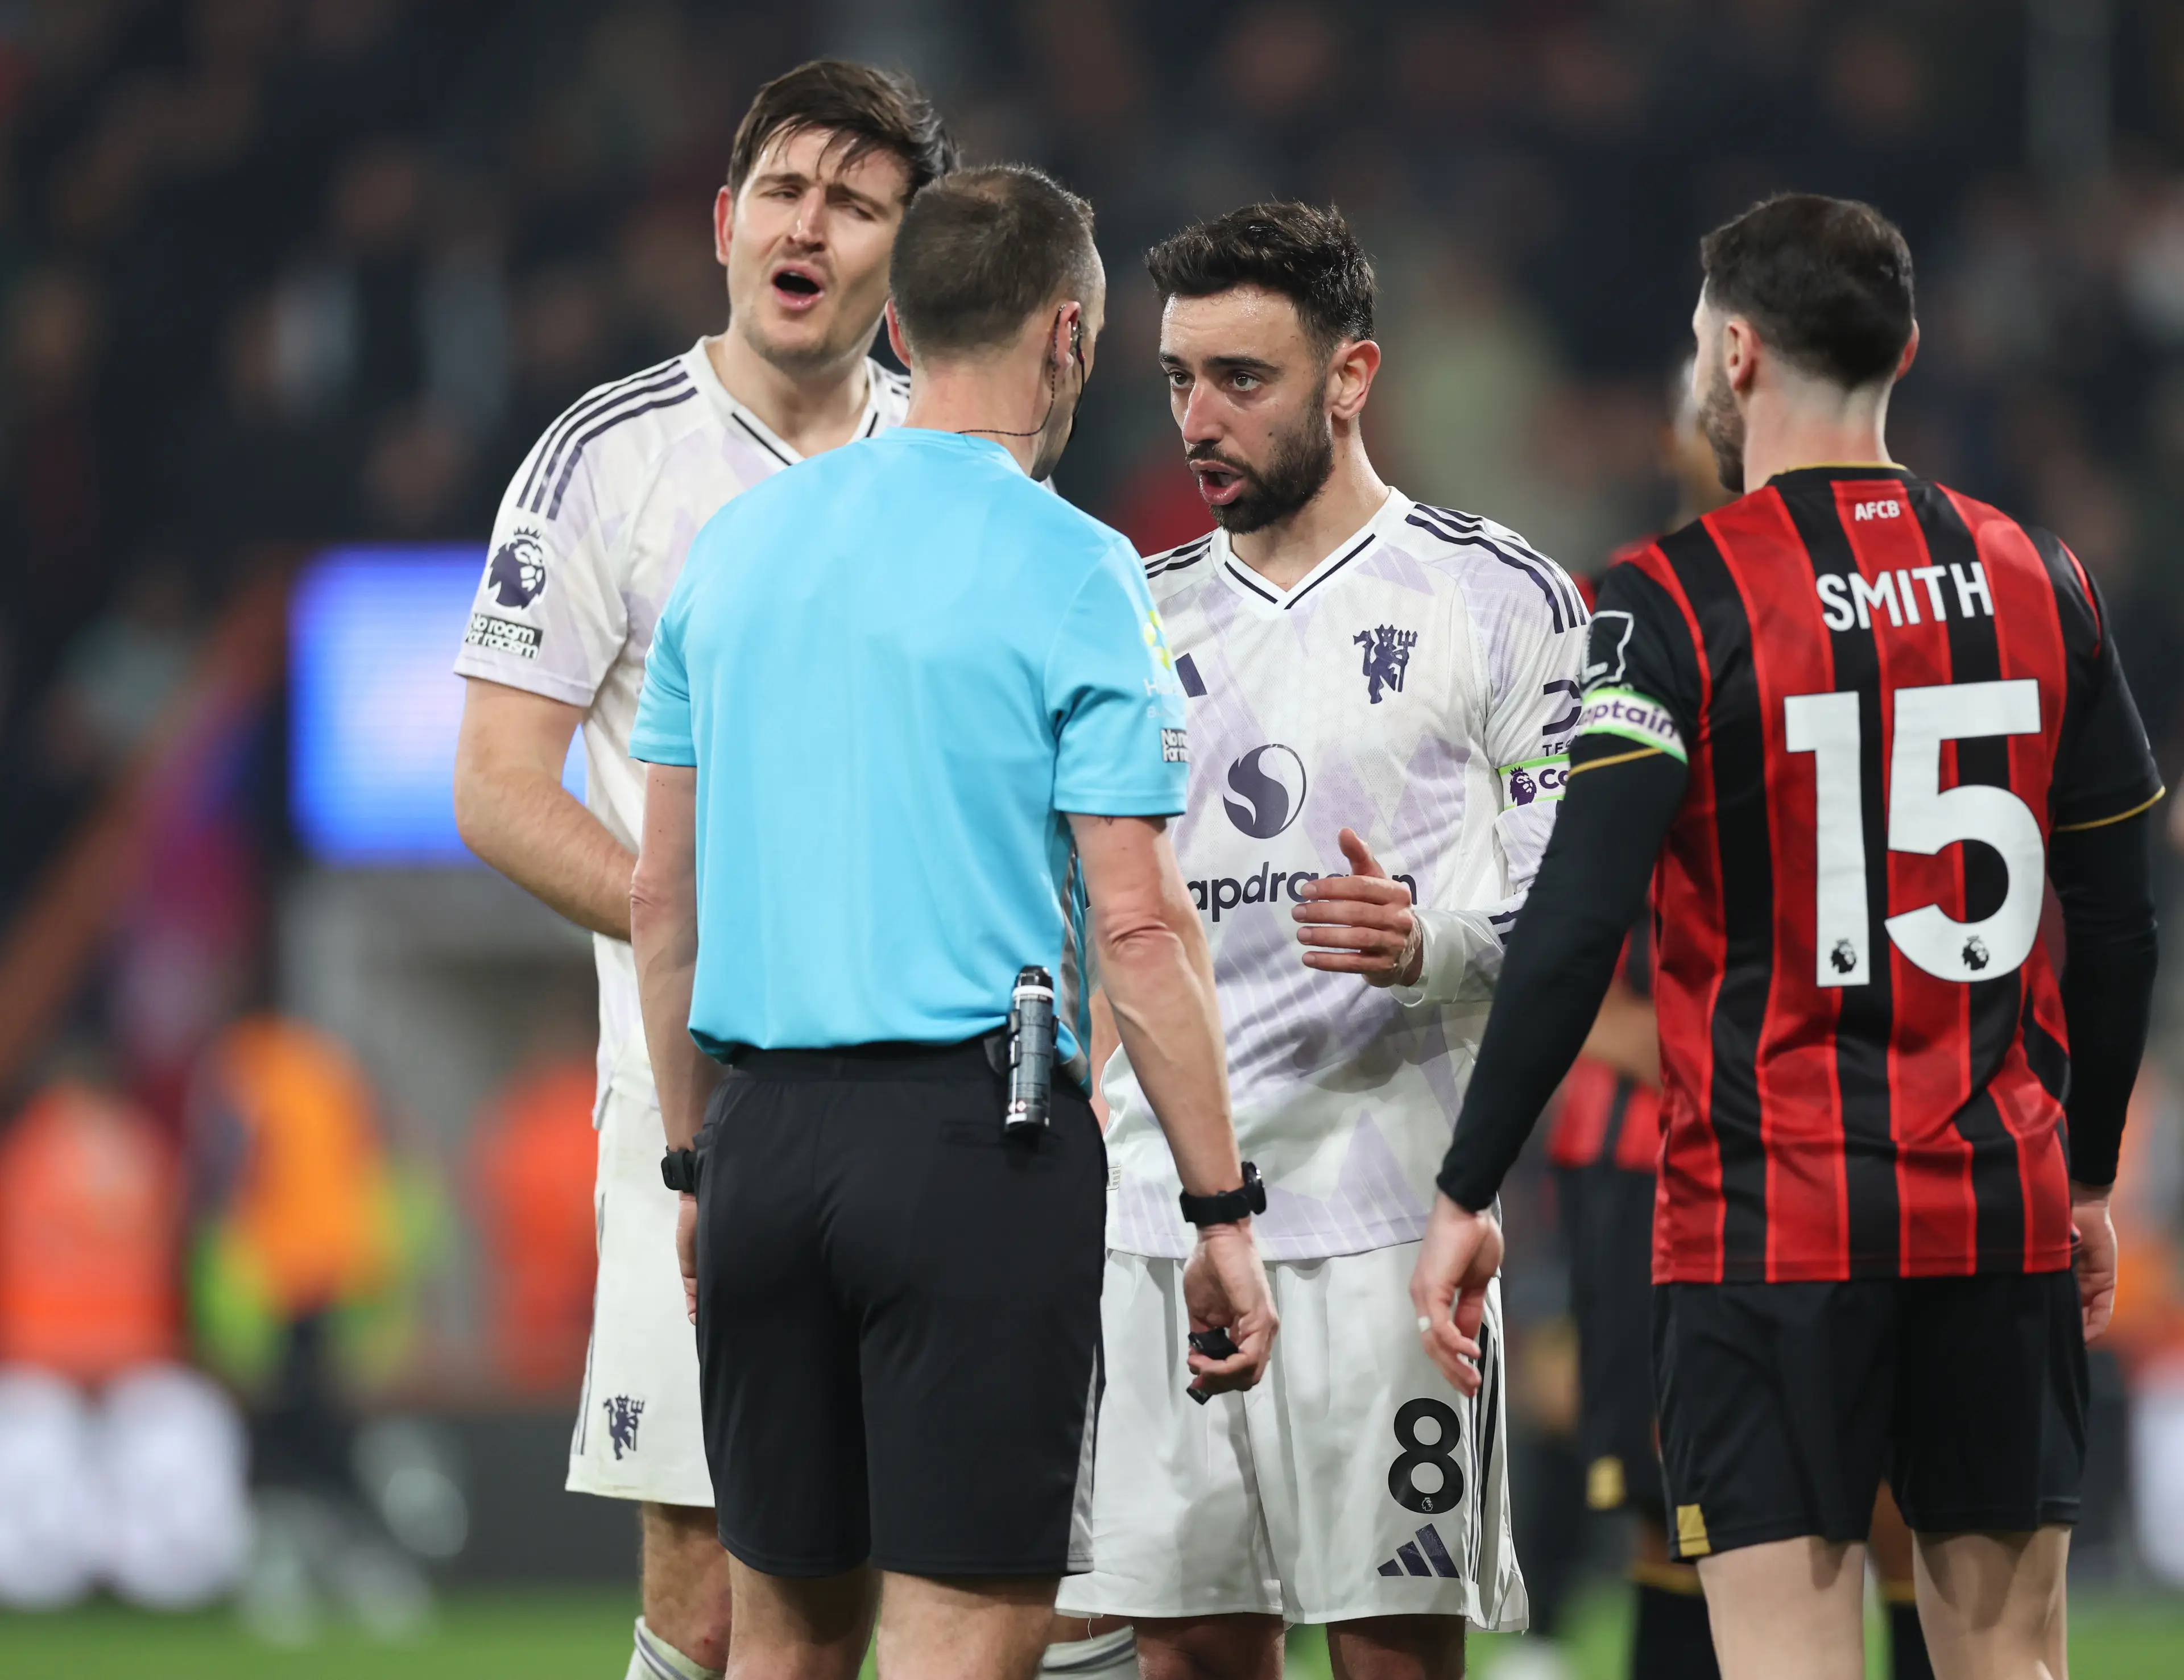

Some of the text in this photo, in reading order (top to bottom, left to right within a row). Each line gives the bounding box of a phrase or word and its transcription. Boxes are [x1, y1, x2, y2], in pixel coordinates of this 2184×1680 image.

[1855, 500, 1900, 521] AFCB
[1816, 561, 1995, 632] SMITH
[471, 613, 535, 645] No room
[482, 632, 539, 661] racism
[1161, 728, 1178, 746] No
[1784, 678, 2046, 987] 15
[1388, 1397, 1465, 1515] 8
